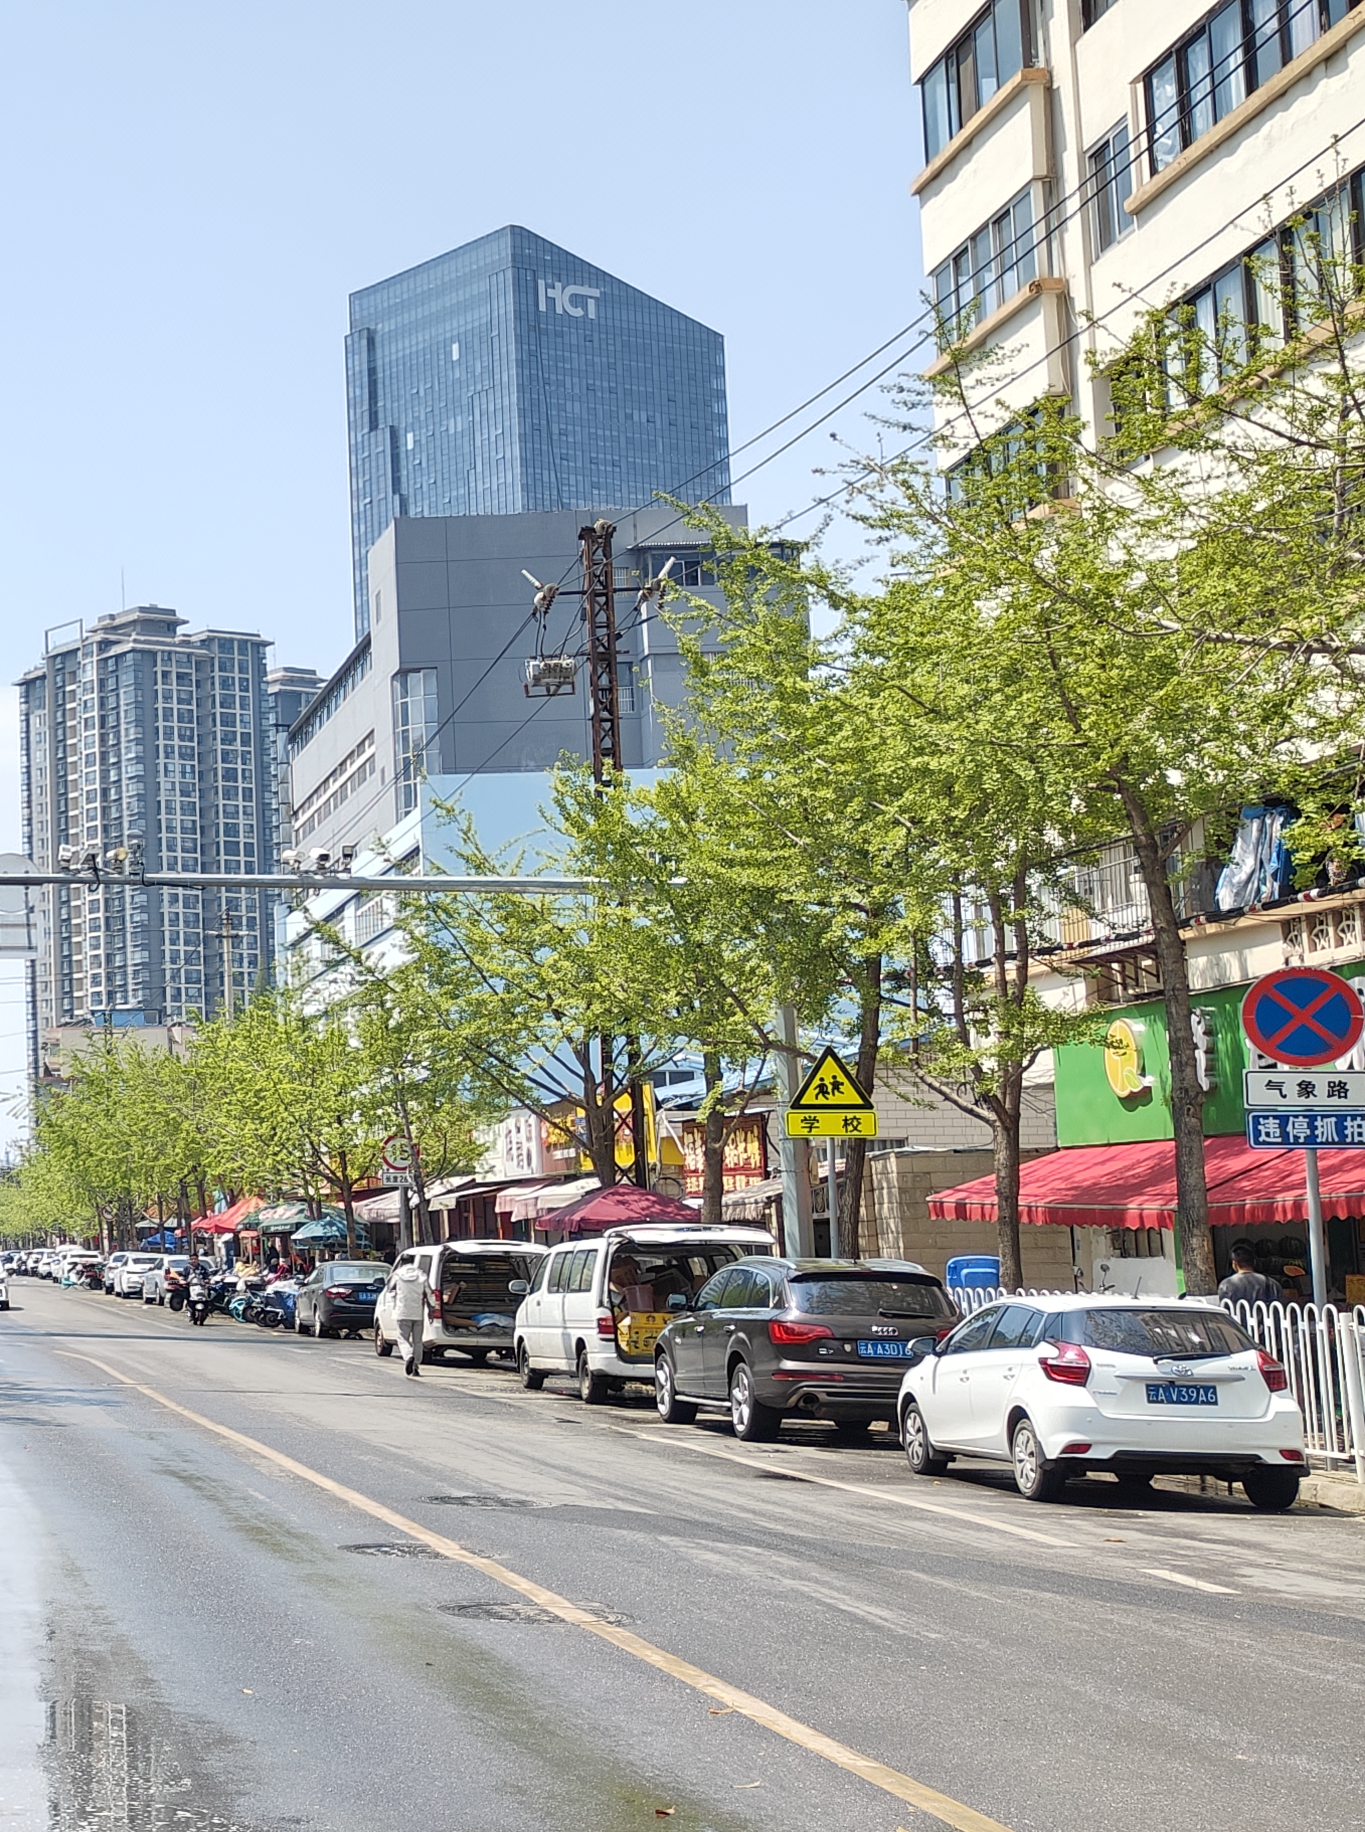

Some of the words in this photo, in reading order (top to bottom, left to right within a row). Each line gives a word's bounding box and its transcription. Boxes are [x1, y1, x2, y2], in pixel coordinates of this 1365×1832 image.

[537, 279, 601, 320] HCT
[1264, 1080, 1350, 1100] 气象路
[800, 1115, 863, 1134] 学校
[1257, 1115, 1365, 1144] 违停抓拍
